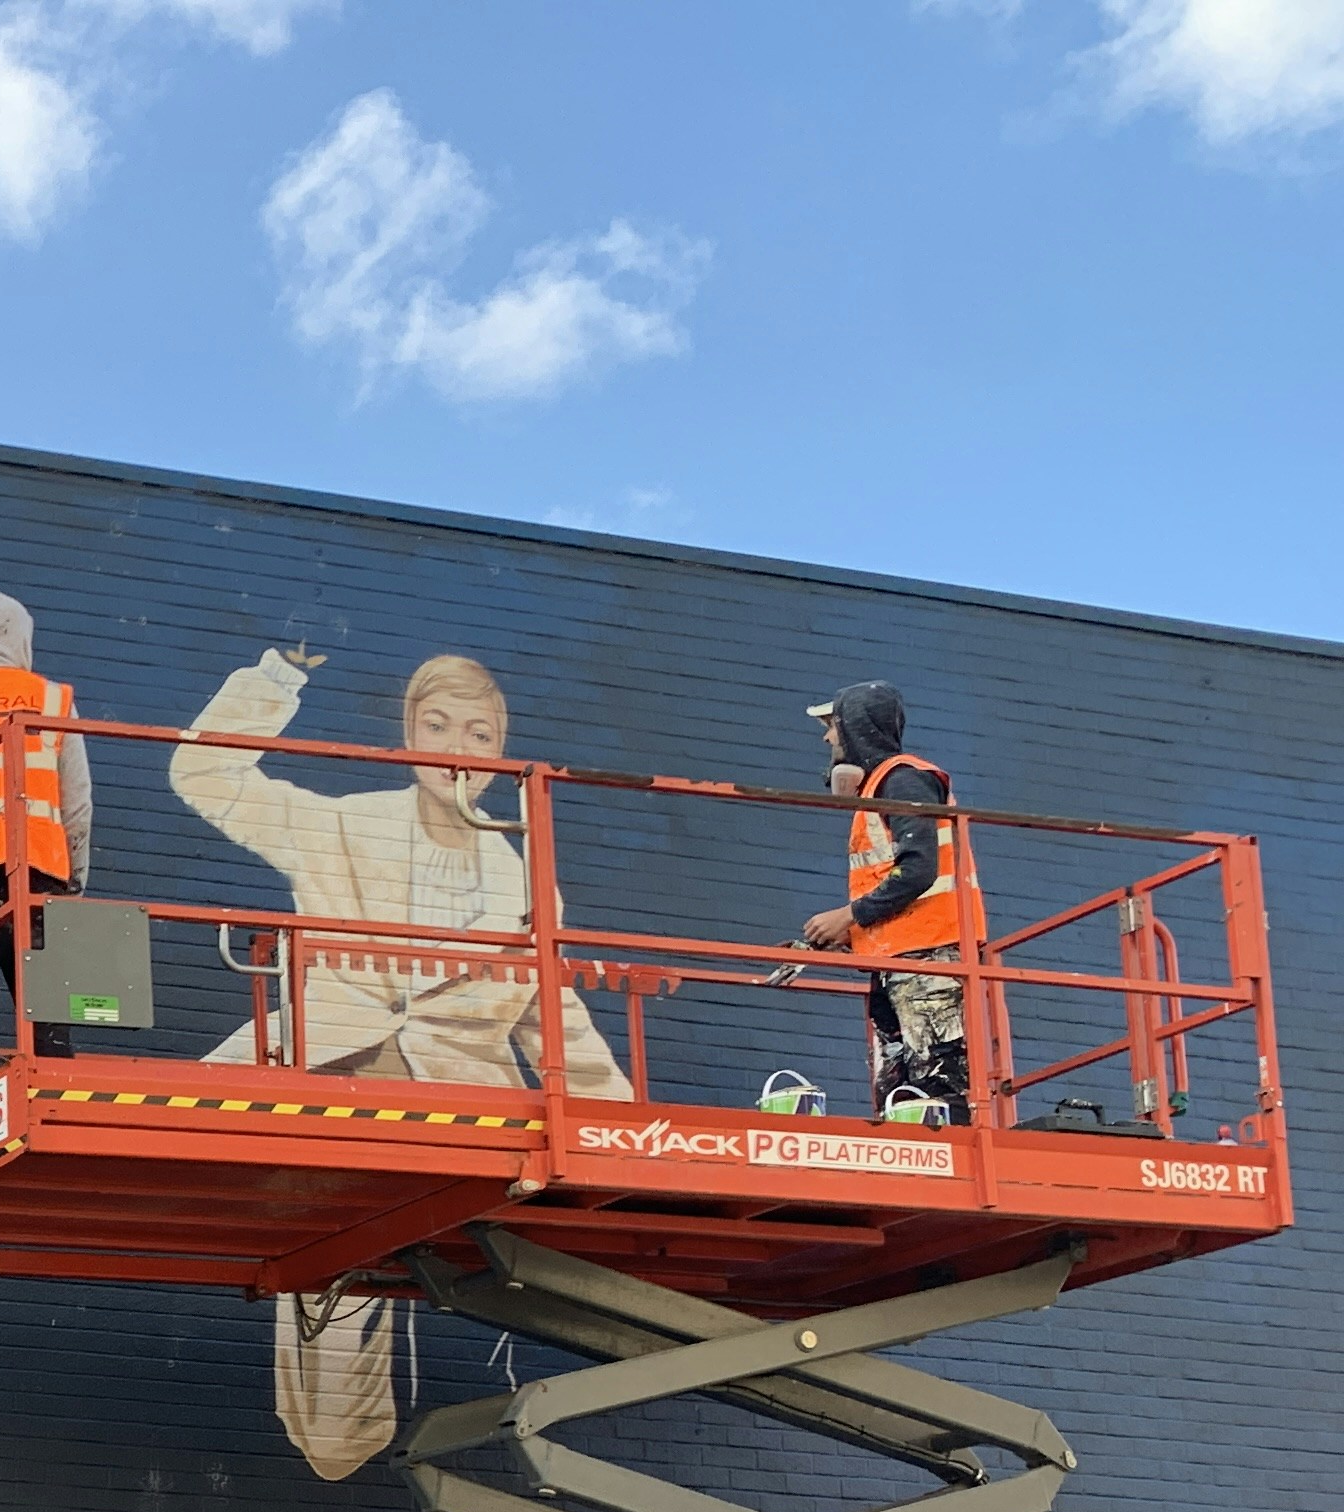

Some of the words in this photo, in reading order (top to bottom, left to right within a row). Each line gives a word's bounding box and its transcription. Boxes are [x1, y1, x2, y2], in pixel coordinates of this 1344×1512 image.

[578, 1118, 745, 1158] SKYJACK
[752, 1133, 801, 1164] PG
[806, 1140, 950, 1171] PLATFORMS
[1140, 1158, 1232, 1194] SJ6832
[1237, 1165, 1270, 1196] RT
